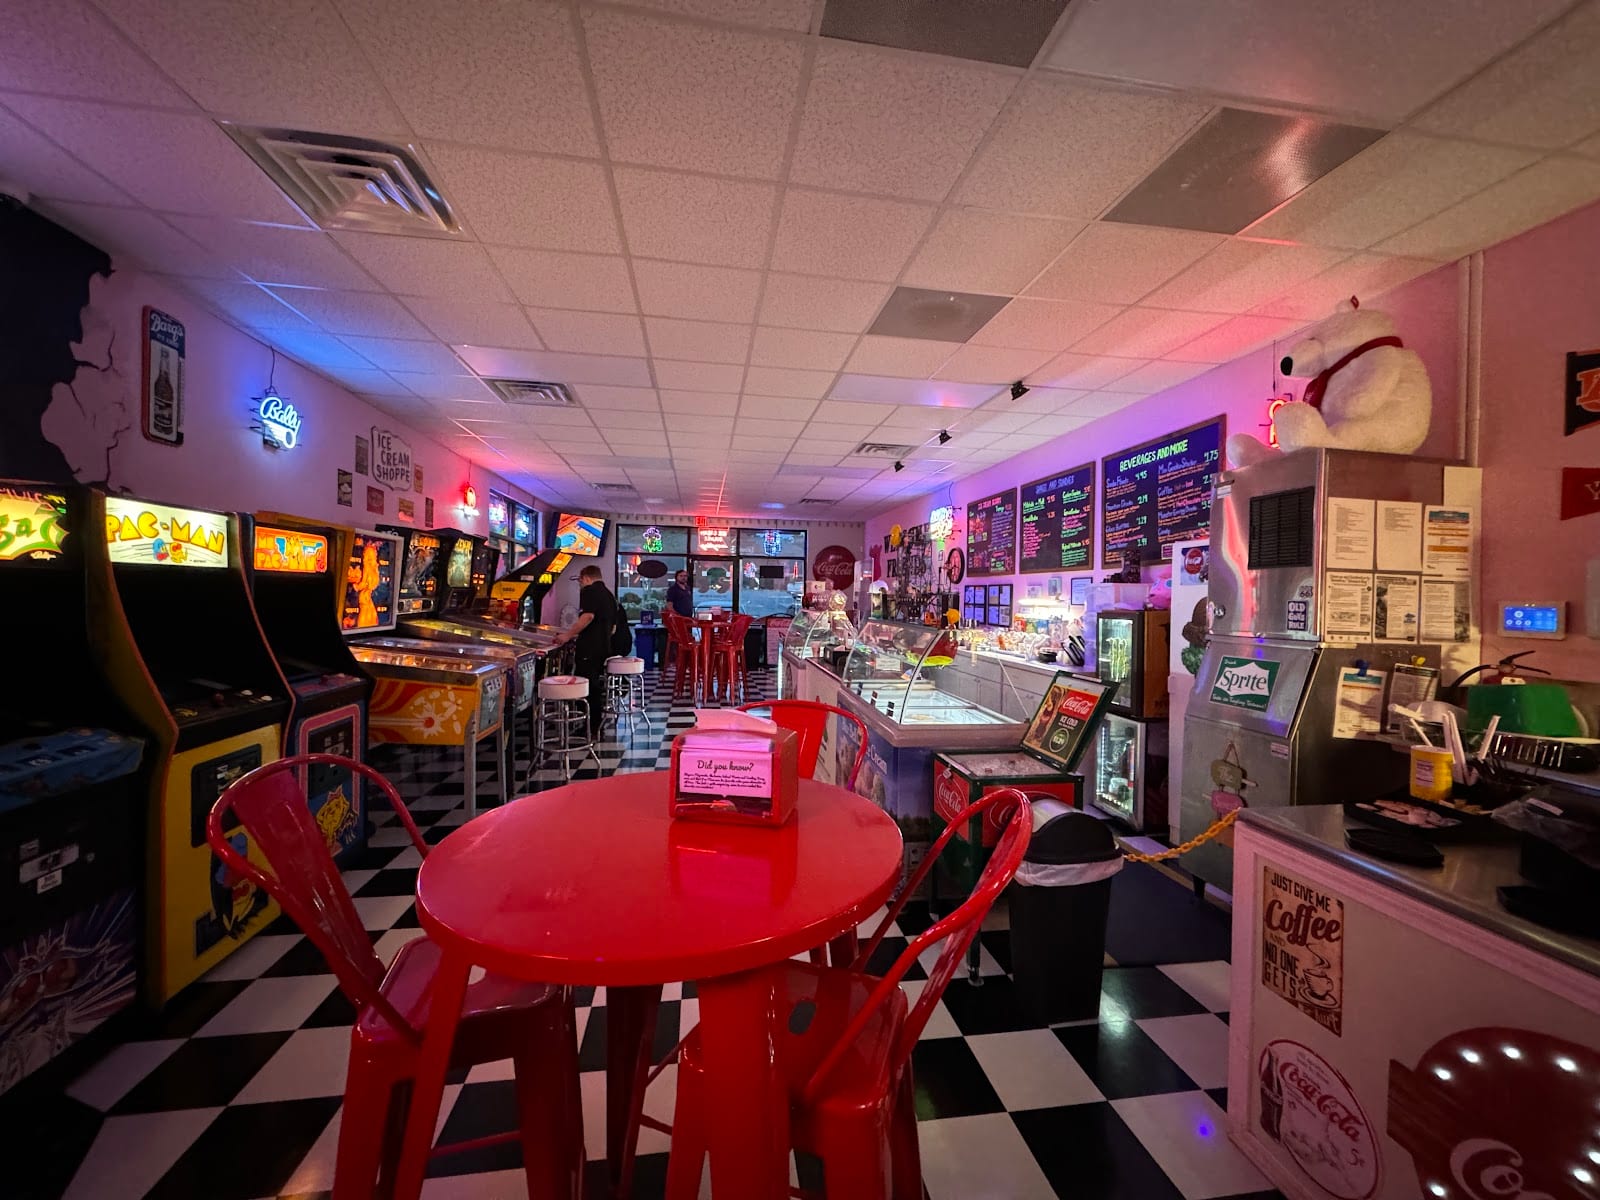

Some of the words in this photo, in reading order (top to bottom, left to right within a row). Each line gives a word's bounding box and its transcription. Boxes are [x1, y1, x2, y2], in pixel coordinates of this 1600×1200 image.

[260, 396, 302, 434] Bally
[377, 434, 392, 451] ICE
[380, 450, 410, 469] CREAM
[1119, 451, 1157, 472] BEVERAGES
[1156, 444, 1170, 461] AND
[1169, 439, 1189, 457] MORE
[376, 464, 410, 483] SHOPPE
[106, 511, 225, 555] PAC-MAN
[1220, 669, 1267, 692] Sprite
[697, 760, 713, 770] Did
[713, 764, 728, 774] you
[729, 761, 754, 772] know?
[1271, 872, 1293, 895] JUST
[1294, 883, 1315, 907] GIVE
[1315, 892, 1332, 914] ME
[1265, 899, 1341, 947] Coffee
[1264, 940, 1278, 964] NO
[1280, 948, 1300, 979] ONE
[1264, 961, 1298, 999] GETS
